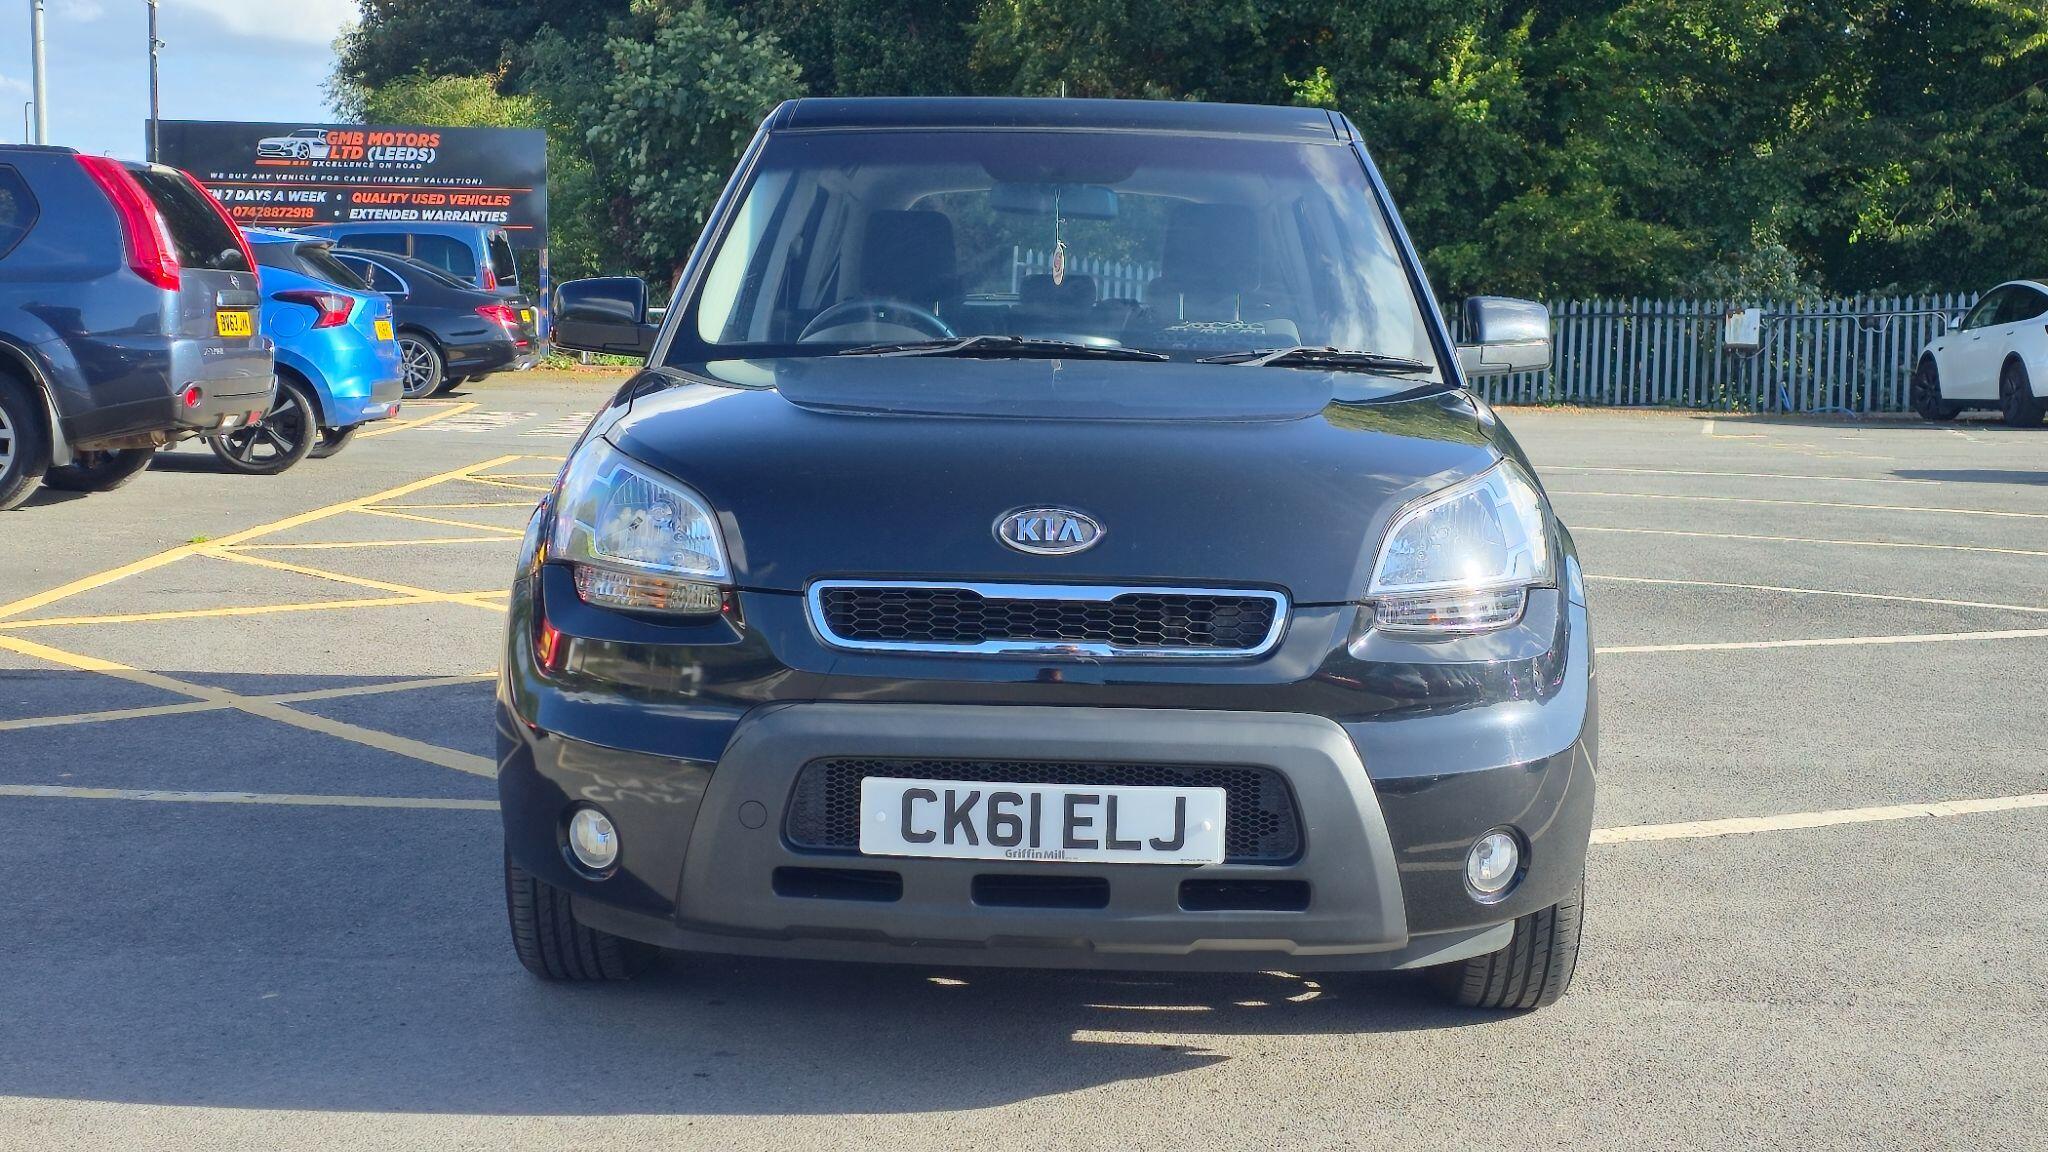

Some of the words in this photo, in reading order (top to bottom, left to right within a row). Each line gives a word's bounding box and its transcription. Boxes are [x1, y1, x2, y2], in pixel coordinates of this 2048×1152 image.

[326, 131, 364, 145] GMB
[368, 132, 440, 147] MOTORS
[329, 145, 364, 159] LTD
[367, 146, 436, 163] (LEEDS)
[312, 160, 375, 168] EXCELLENCE
[395, 162, 422, 170] ROAD
[423, 177, 483, 185] VALUATION)
[224, 189, 234, 200] 7
[235, 190, 272, 201] DAYS
[273, 190, 284, 201] A
[288, 191, 328, 203] WEEK
[352, 192, 409, 204] QUALITY
[412, 193, 446, 205] USED
[449, 194, 511, 206] VEHICLES
[349, 208, 419, 220] EXTENDED
[422, 210, 508, 222] WARRANTIES
[1017, 517, 1084, 542] KIA
[901, 788, 1042, 849] CK61
[1062, 793, 1187, 852] ELJ
